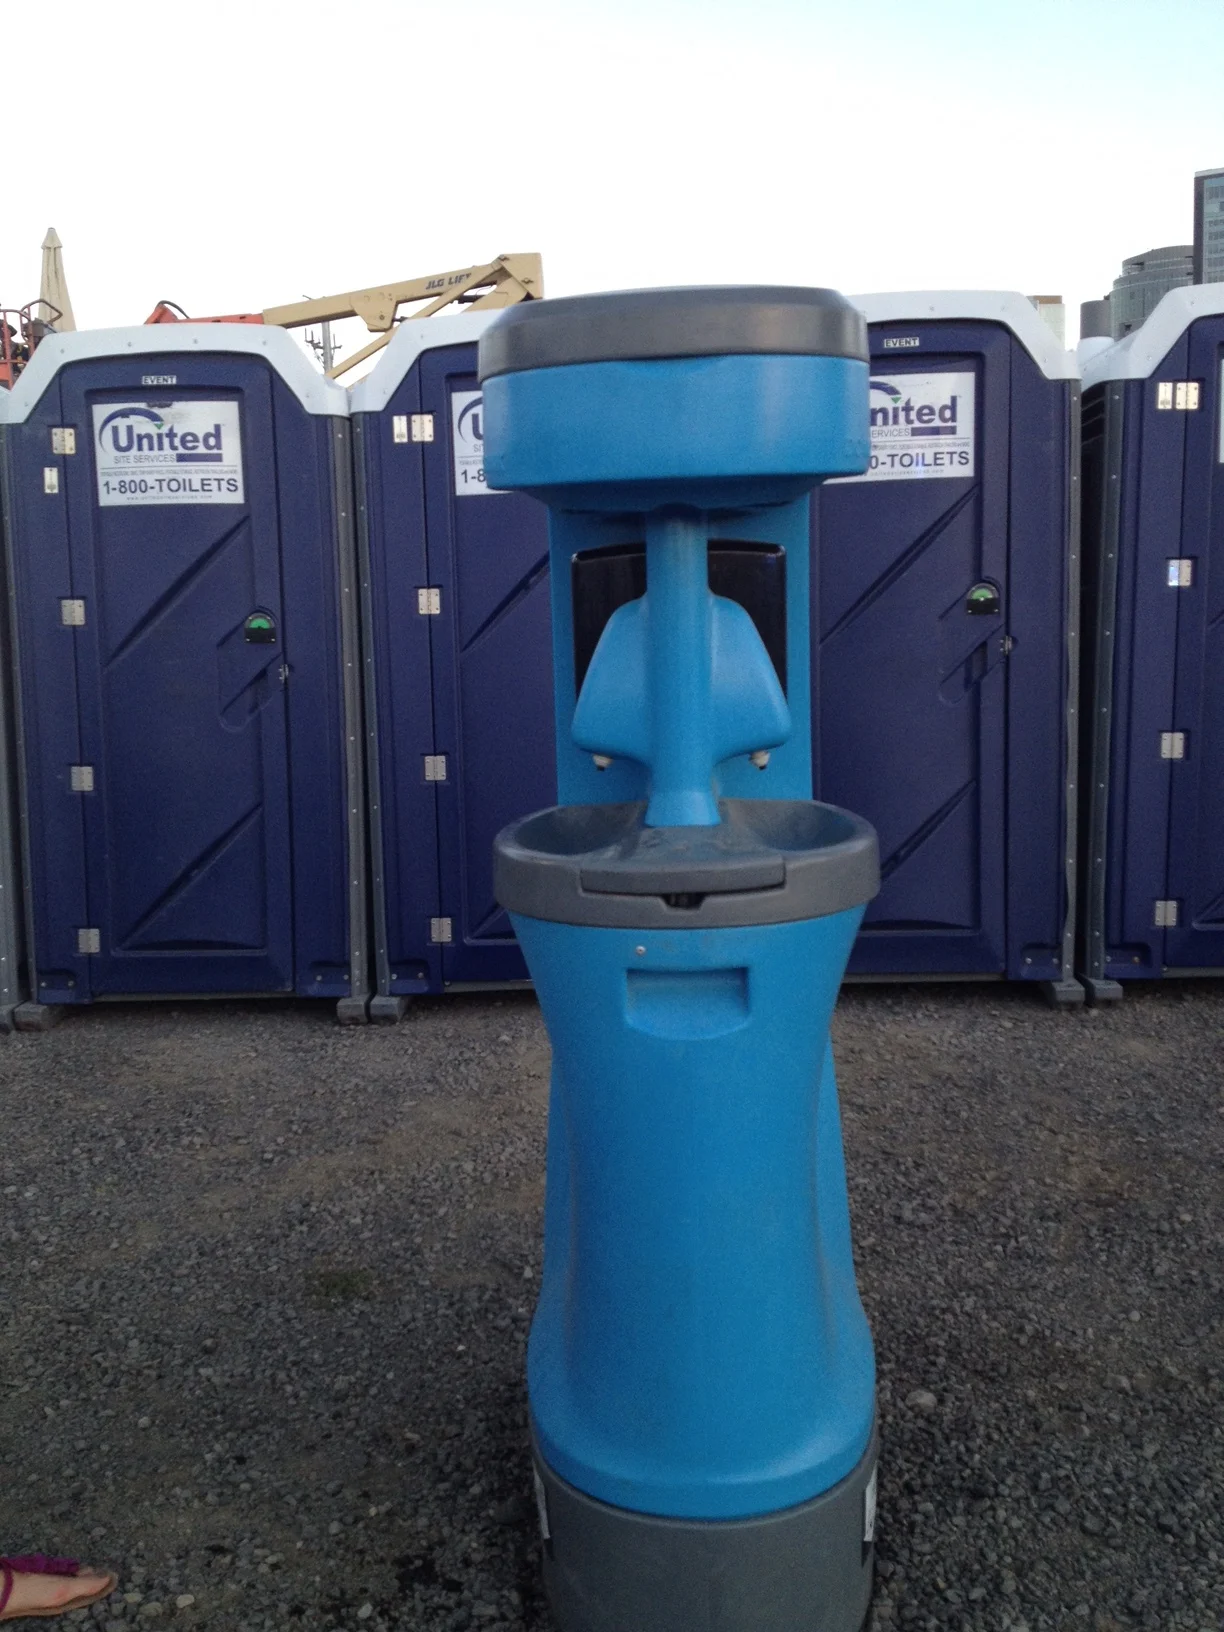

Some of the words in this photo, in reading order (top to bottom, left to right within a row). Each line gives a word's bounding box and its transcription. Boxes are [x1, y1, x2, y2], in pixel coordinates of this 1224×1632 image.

[425, 278, 445, 290] JLG
[885, 337, 918, 347] EVENT
[143, 375, 176, 385] EVENT
[870, 395, 958, 426] nited
[111, 423, 223, 453] United
[871, 428, 911, 438] ERVICES
[113, 455, 131, 464] SITE
[133, 454, 176, 463] SERVICES
[869, 451, 970, 469] 0-TOILETS
[103, 478, 239, 495] 1-800-TOILETS
